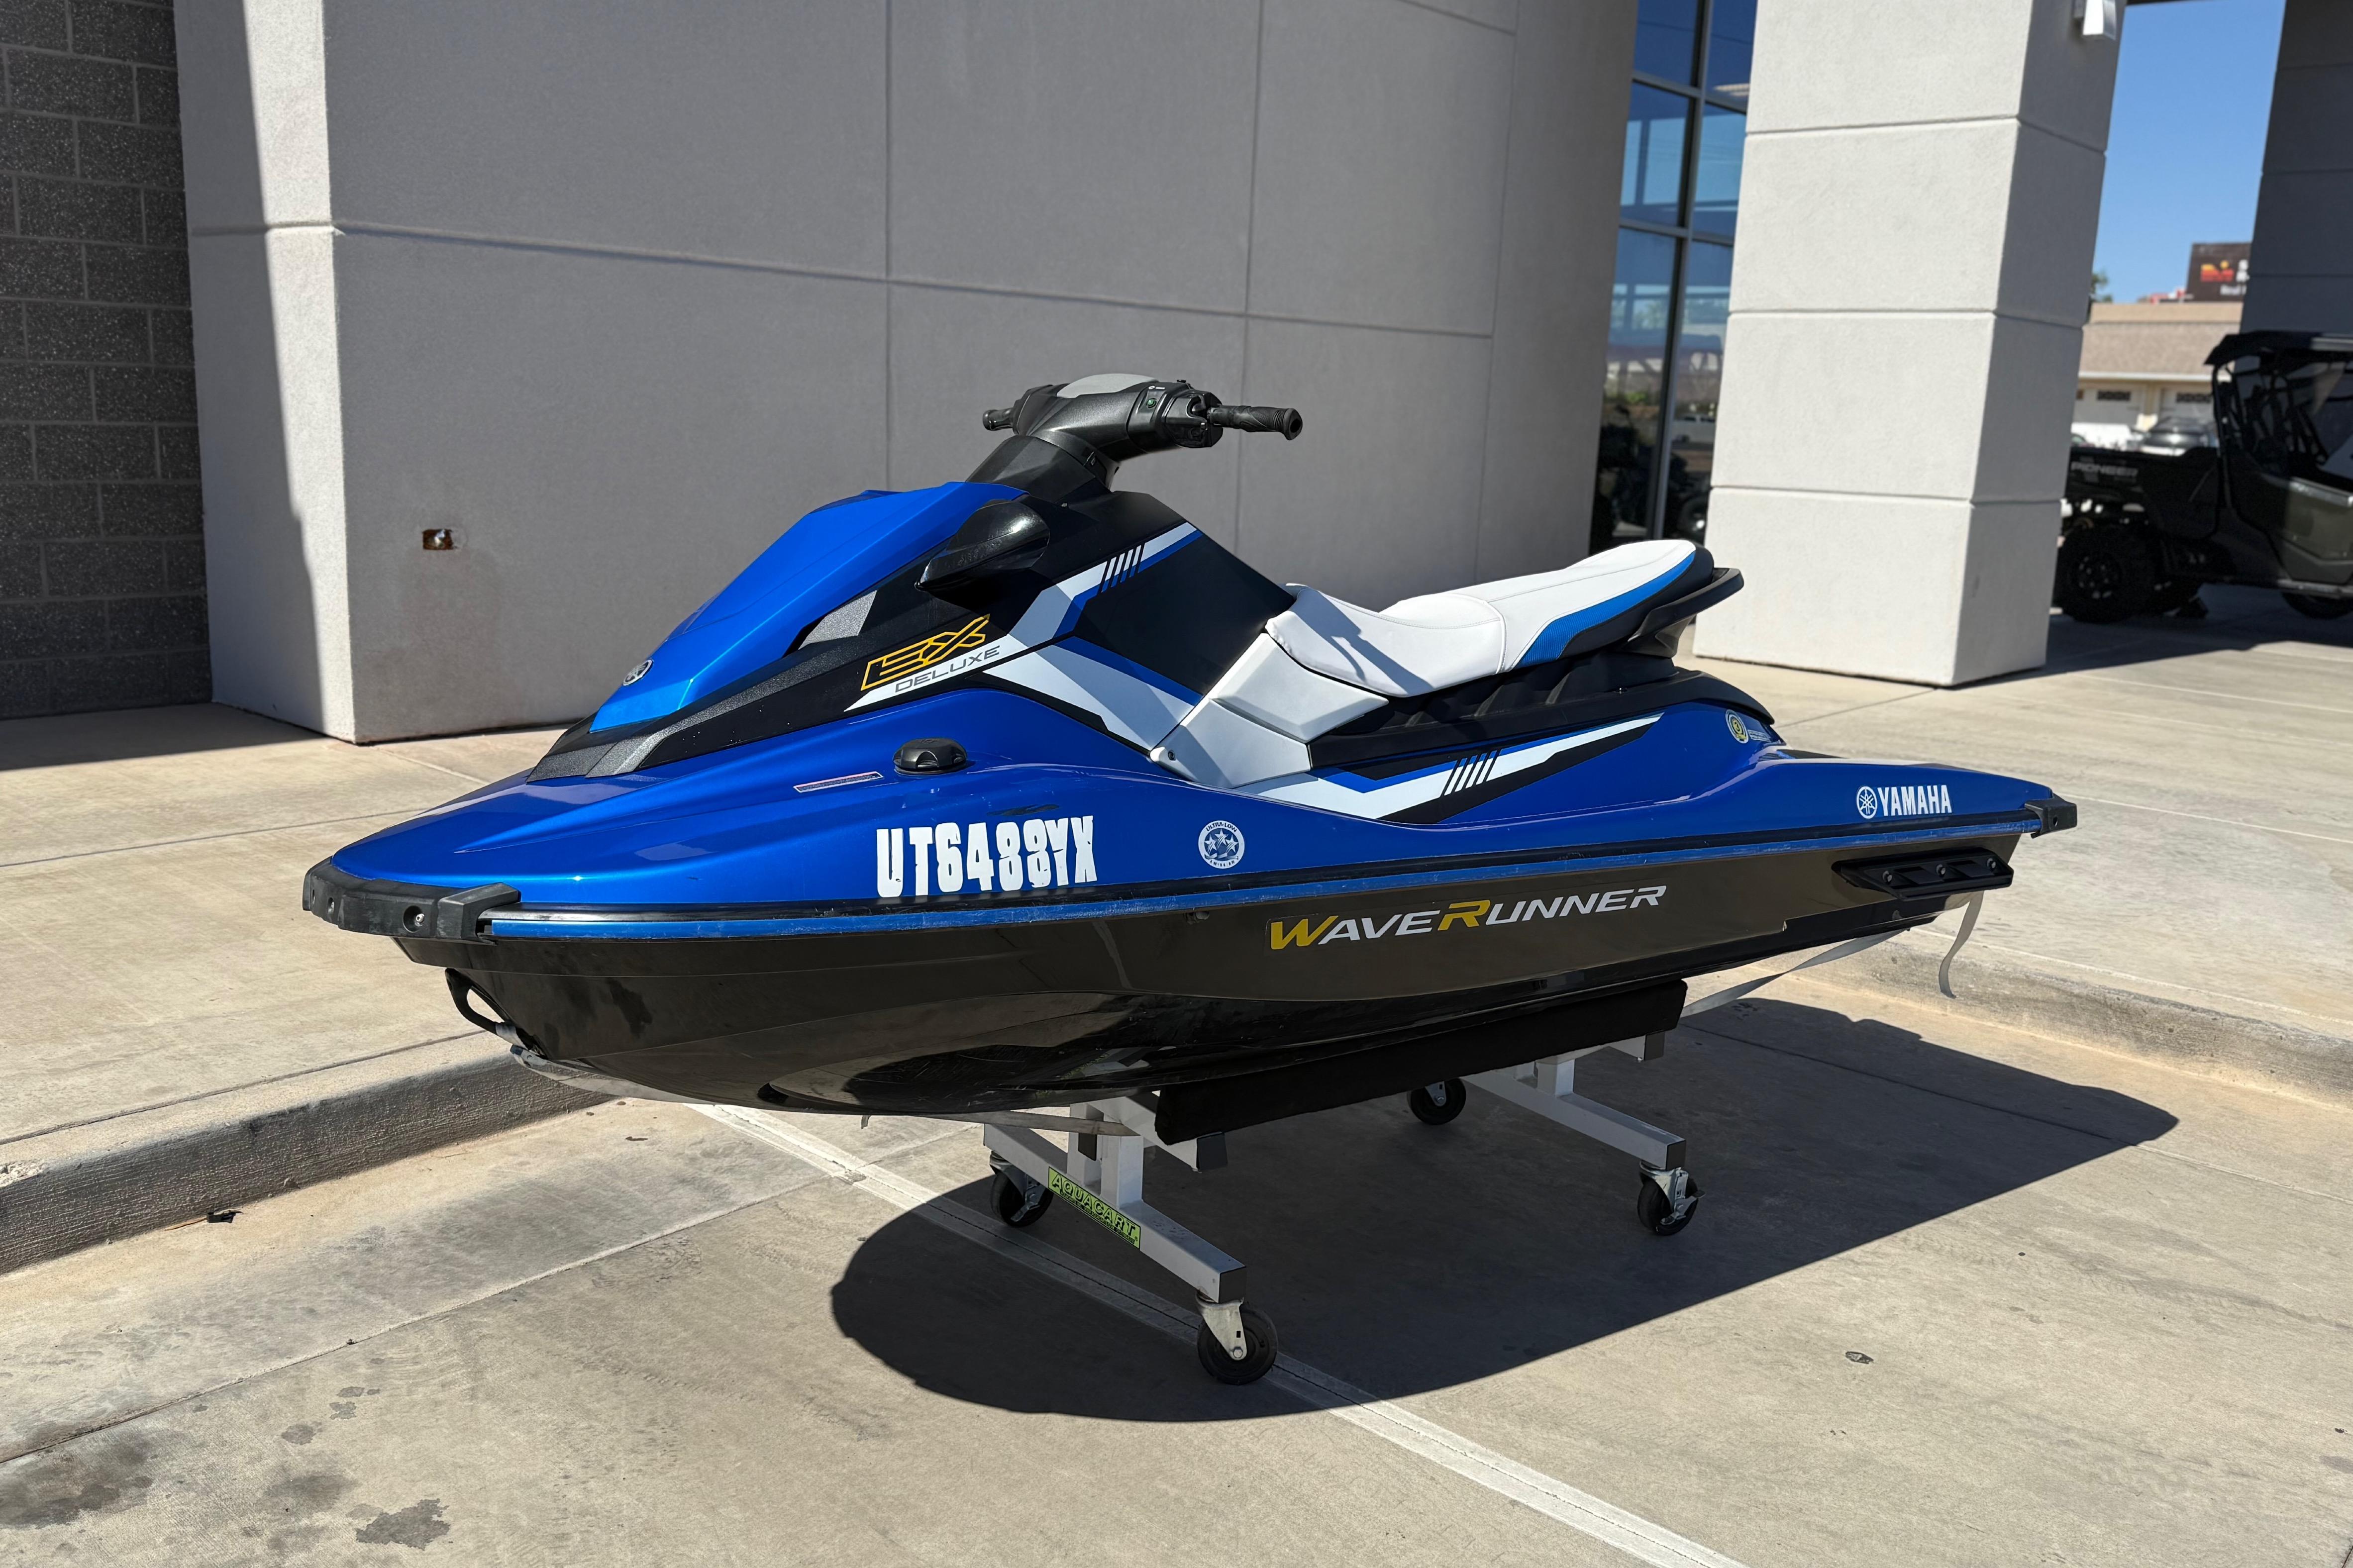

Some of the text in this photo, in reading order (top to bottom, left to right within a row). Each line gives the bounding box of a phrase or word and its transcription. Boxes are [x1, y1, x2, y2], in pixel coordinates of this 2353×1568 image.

[860, 613, 991, 691] EX
[895, 645, 1000, 692] DELUXE
[1877, 784, 1952, 816] YAMAHA
[876, 815, 1097, 897] UT6488YX
[1271, 885, 1667, 950] WAVERUNNER
[1051, 1174, 1136, 1237] AQUACART
